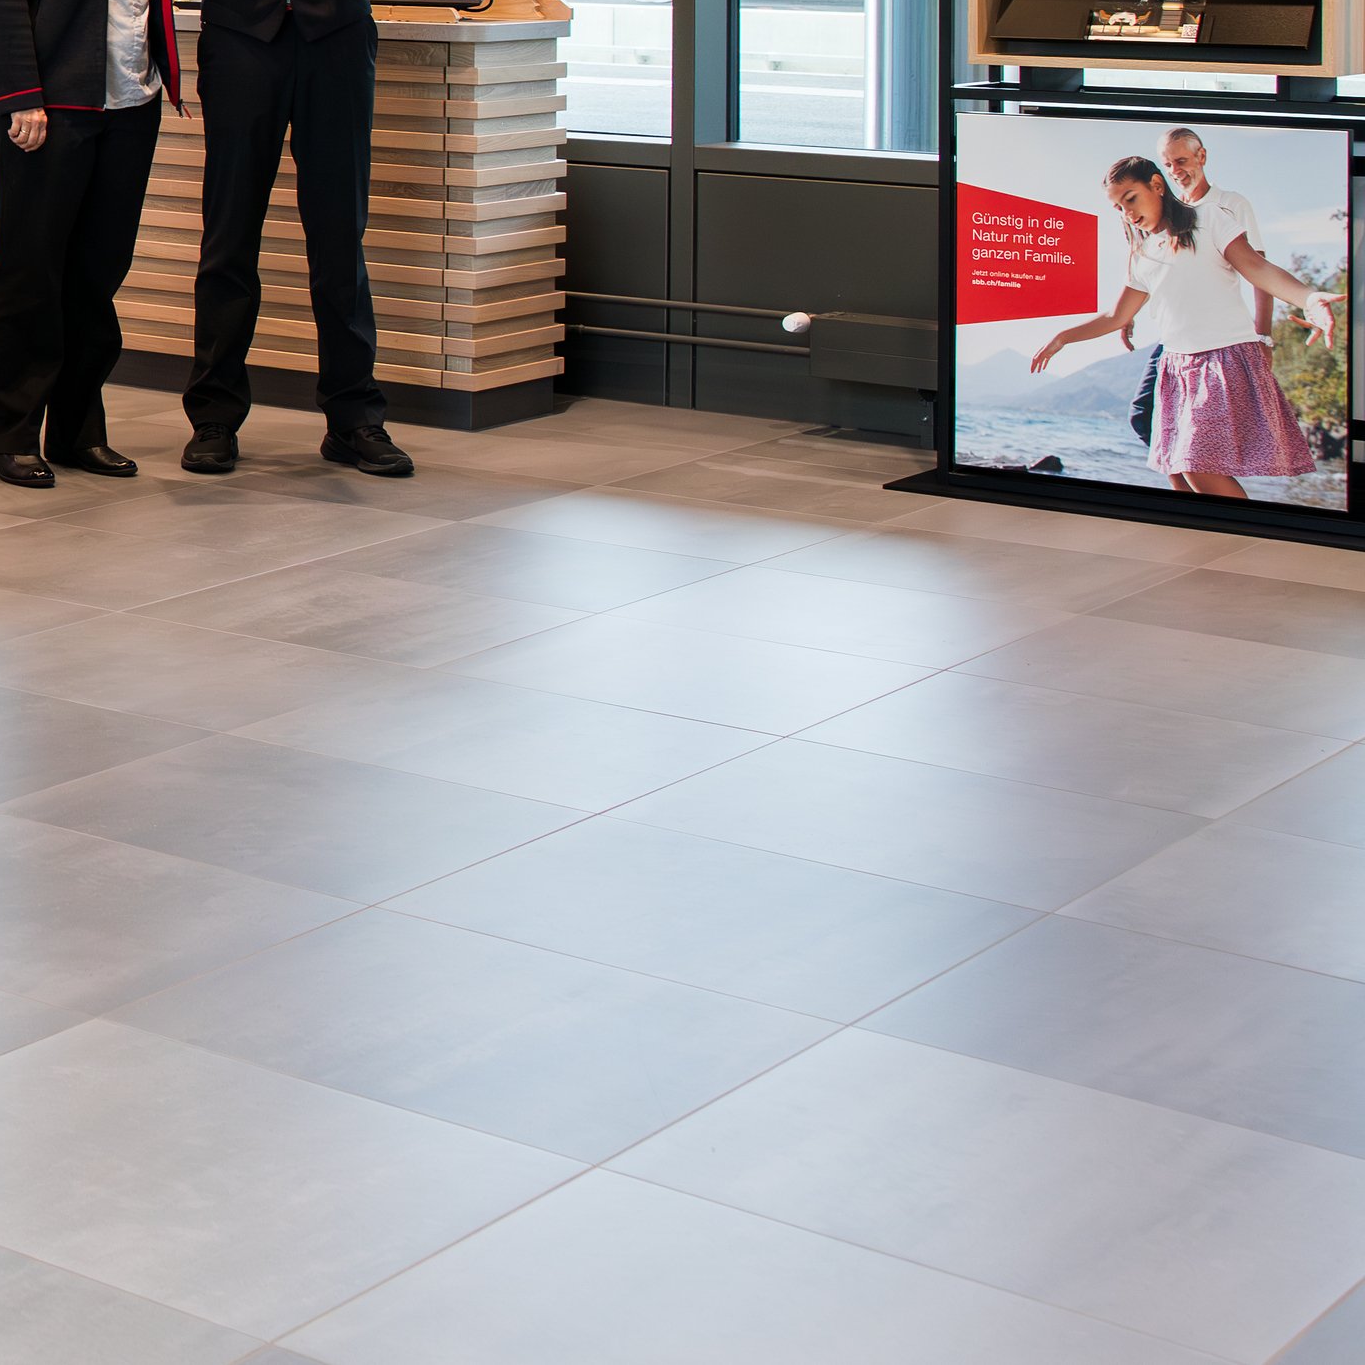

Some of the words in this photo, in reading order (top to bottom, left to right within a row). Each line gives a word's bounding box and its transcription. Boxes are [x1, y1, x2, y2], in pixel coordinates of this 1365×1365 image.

[972, 212, 1024, 230] Günstig
[1028, 216, 1040, 228] in
[1043, 217, 1065, 230] die
[972, 229, 1009, 242] Natur
[1013, 233, 1034, 245] mit
[1037, 234, 1061, 246] der
[972, 248, 1020, 261] ganzen
[1025, 249, 1075, 265] Familie.
[972, 279, 1021, 288] sbb.ch/familie
[989, 270, 1010, 278] online
[1011, 272, 1034, 280] kaufen
